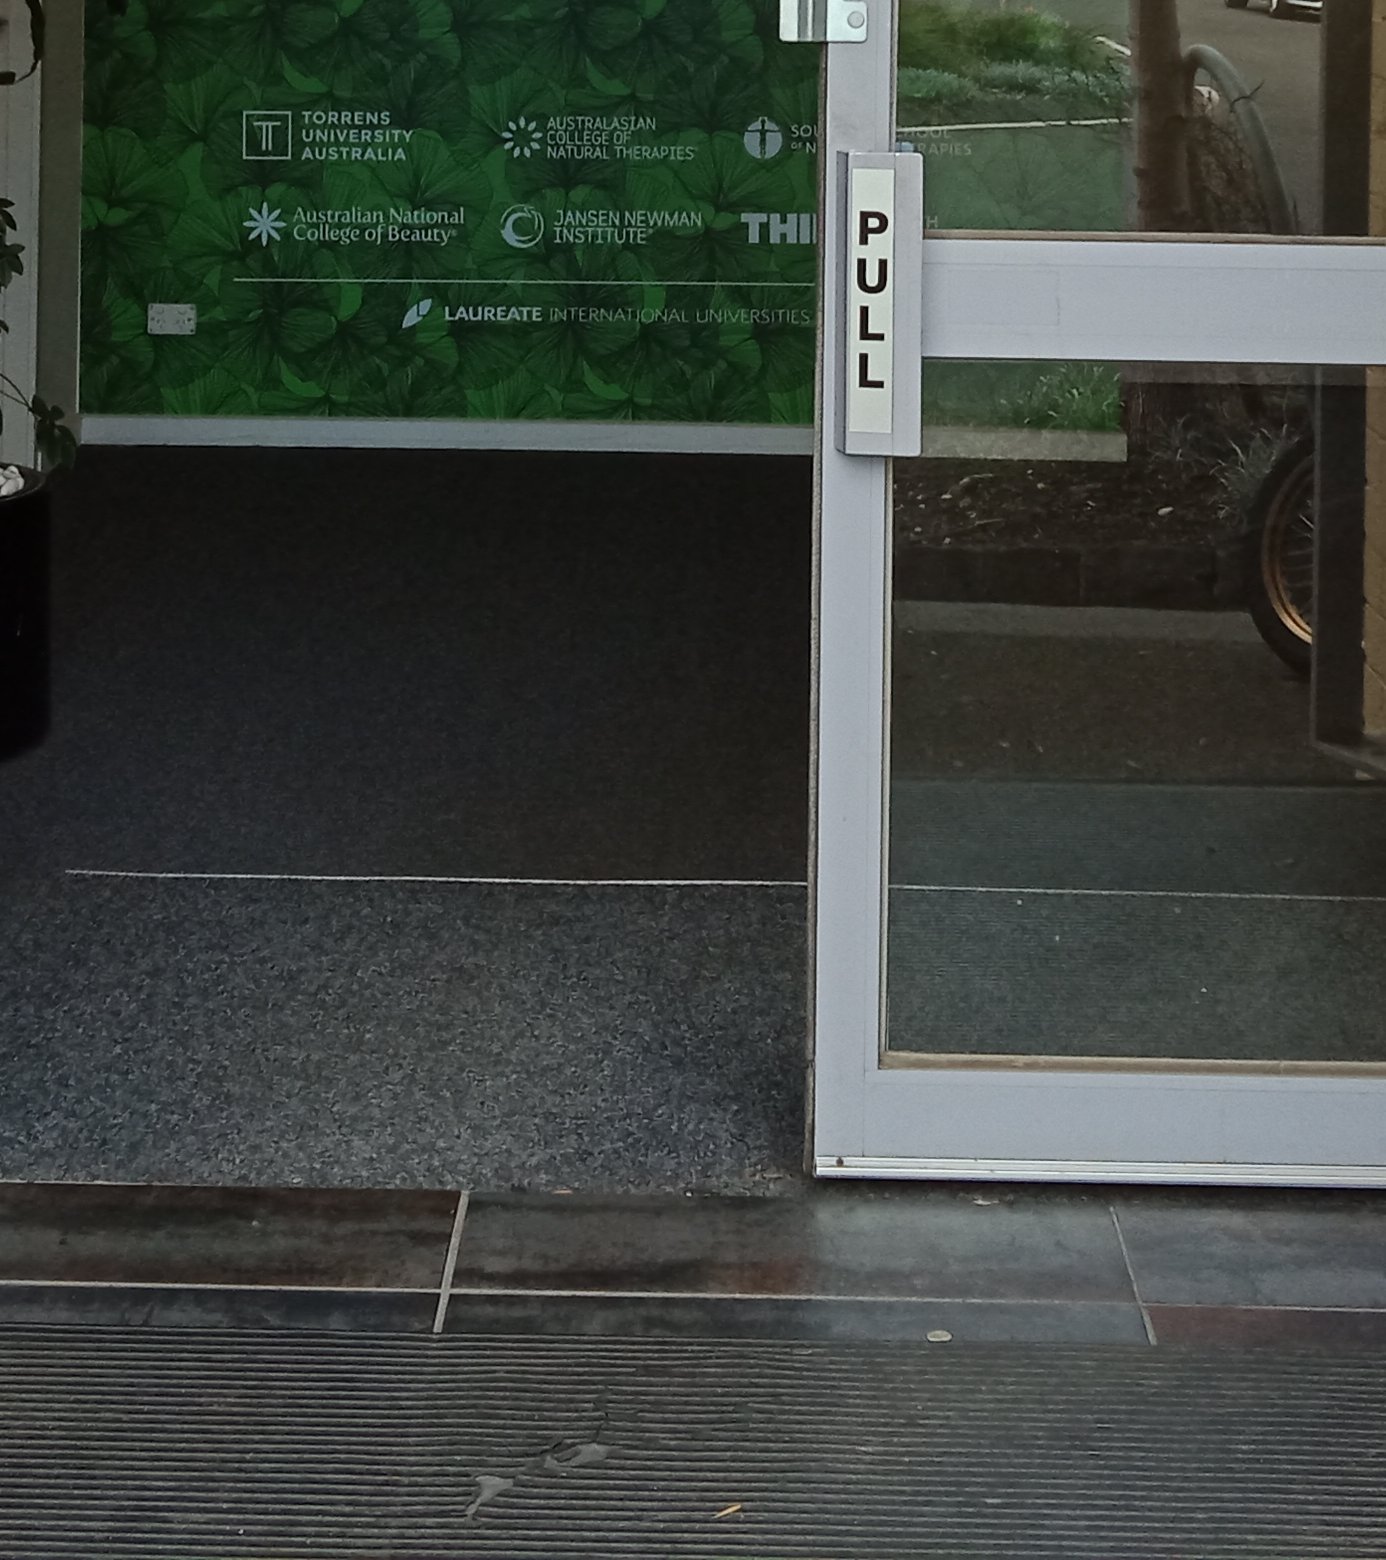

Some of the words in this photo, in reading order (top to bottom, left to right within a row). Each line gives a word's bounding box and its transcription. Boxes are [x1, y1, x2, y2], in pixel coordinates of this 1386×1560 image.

[301, 111, 391, 125] TORRENS
[546, 116, 657, 131] AUSTRALASIAN
[301, 129, 414, 143] UNIVERSITY
[546, 131, 610, 145] COLLEGE
[613, 131, 632, 145] OF
[301, 146, 407, 161] AUSTRALIA
[546, 146, 610, 160] NATURAL
[614, 146, 695, 160] THERAPIES
[293, 206, 384, 224] Australian
[389, 206, 465, 225] National
[553, 209, 620, 227] JANSEN
[624, 210, 703, 228] NEWMAN
[293, 225, 360, 246] College
[365, 225, 384, 245] of
[553, 227, 647, 244] INSTITUTE
[740, 212, 819, 245] THI
[855, 210, 889, 389] PULL
[443, 306, 543, 322] LAUREATE
[549, 307, 689, 323] INTERNATIONAL
[695, 308, 811, 325] UNIVERSITIES
